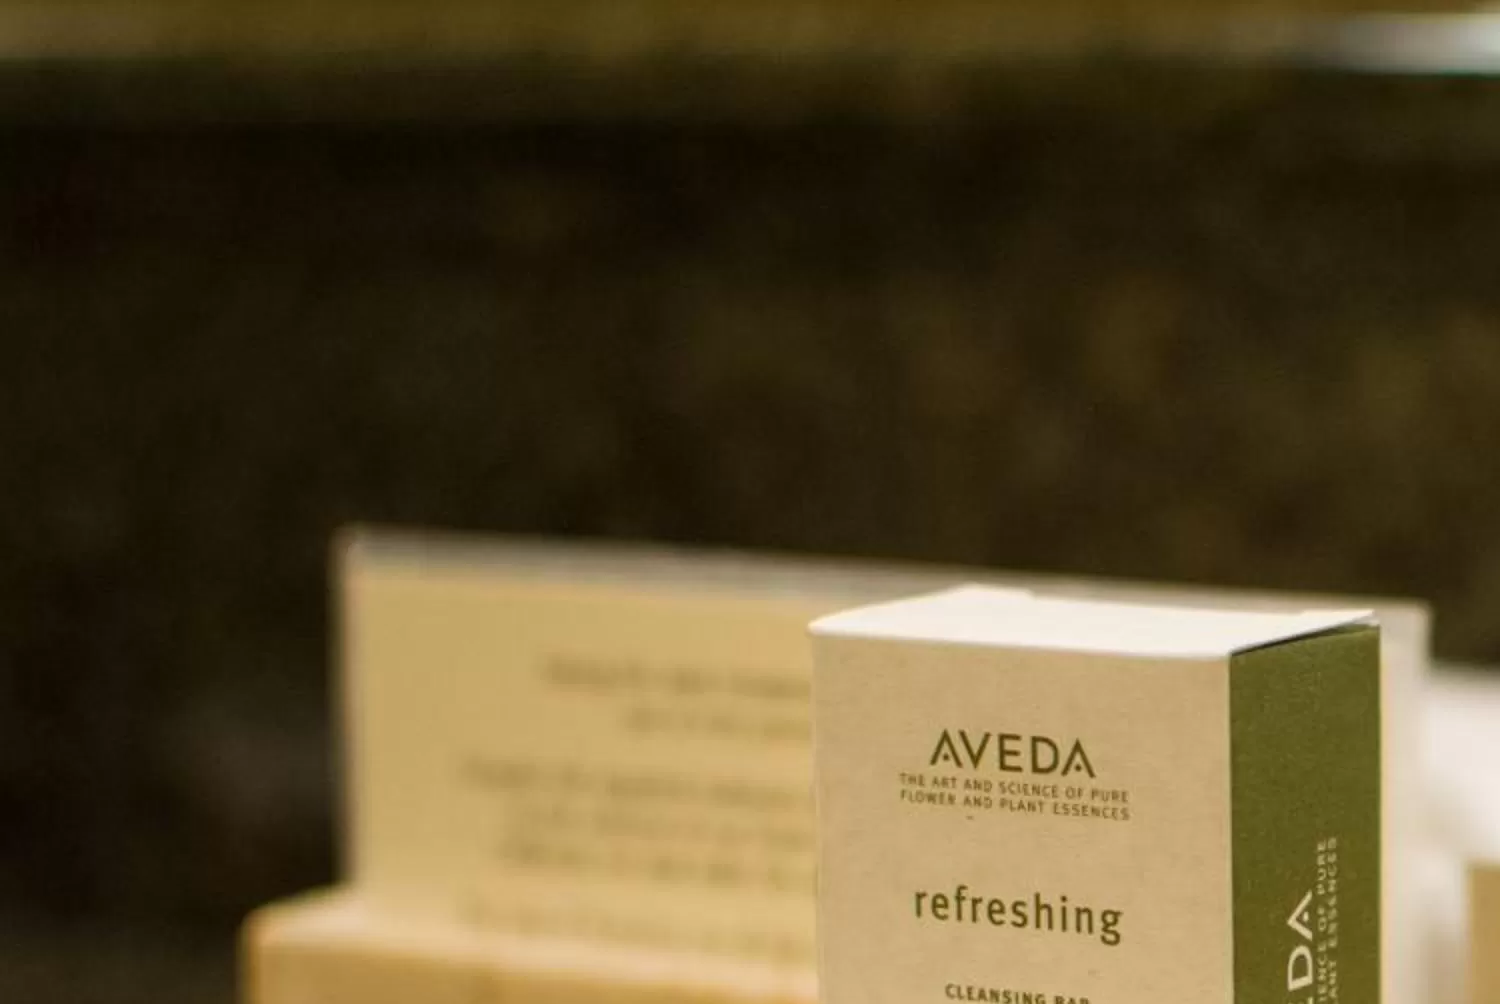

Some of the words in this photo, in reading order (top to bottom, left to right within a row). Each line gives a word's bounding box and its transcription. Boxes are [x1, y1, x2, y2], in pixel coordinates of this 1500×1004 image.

[929, 728, 1096, 779] AVEDA
[899, 772, 925, 787] THE
[931, 775, 957, 789] ART
[963, 778, 993, 793] AND
[999, 781, 1058, 799] SCIENCE
[1065, 786, 1085, 800] OF
[1091, 788, 1130, 803] PURE
[900, 789, 957, 805] FLOWER
[963, 794, 993, 809] AND
[1000, 797, 1045, 814] PLANT
[1053, 803, 1131, 821] ESSENCES
[1316, 839, 1328, 895] PURE
[914, 884, 1123, 946] refreshing
